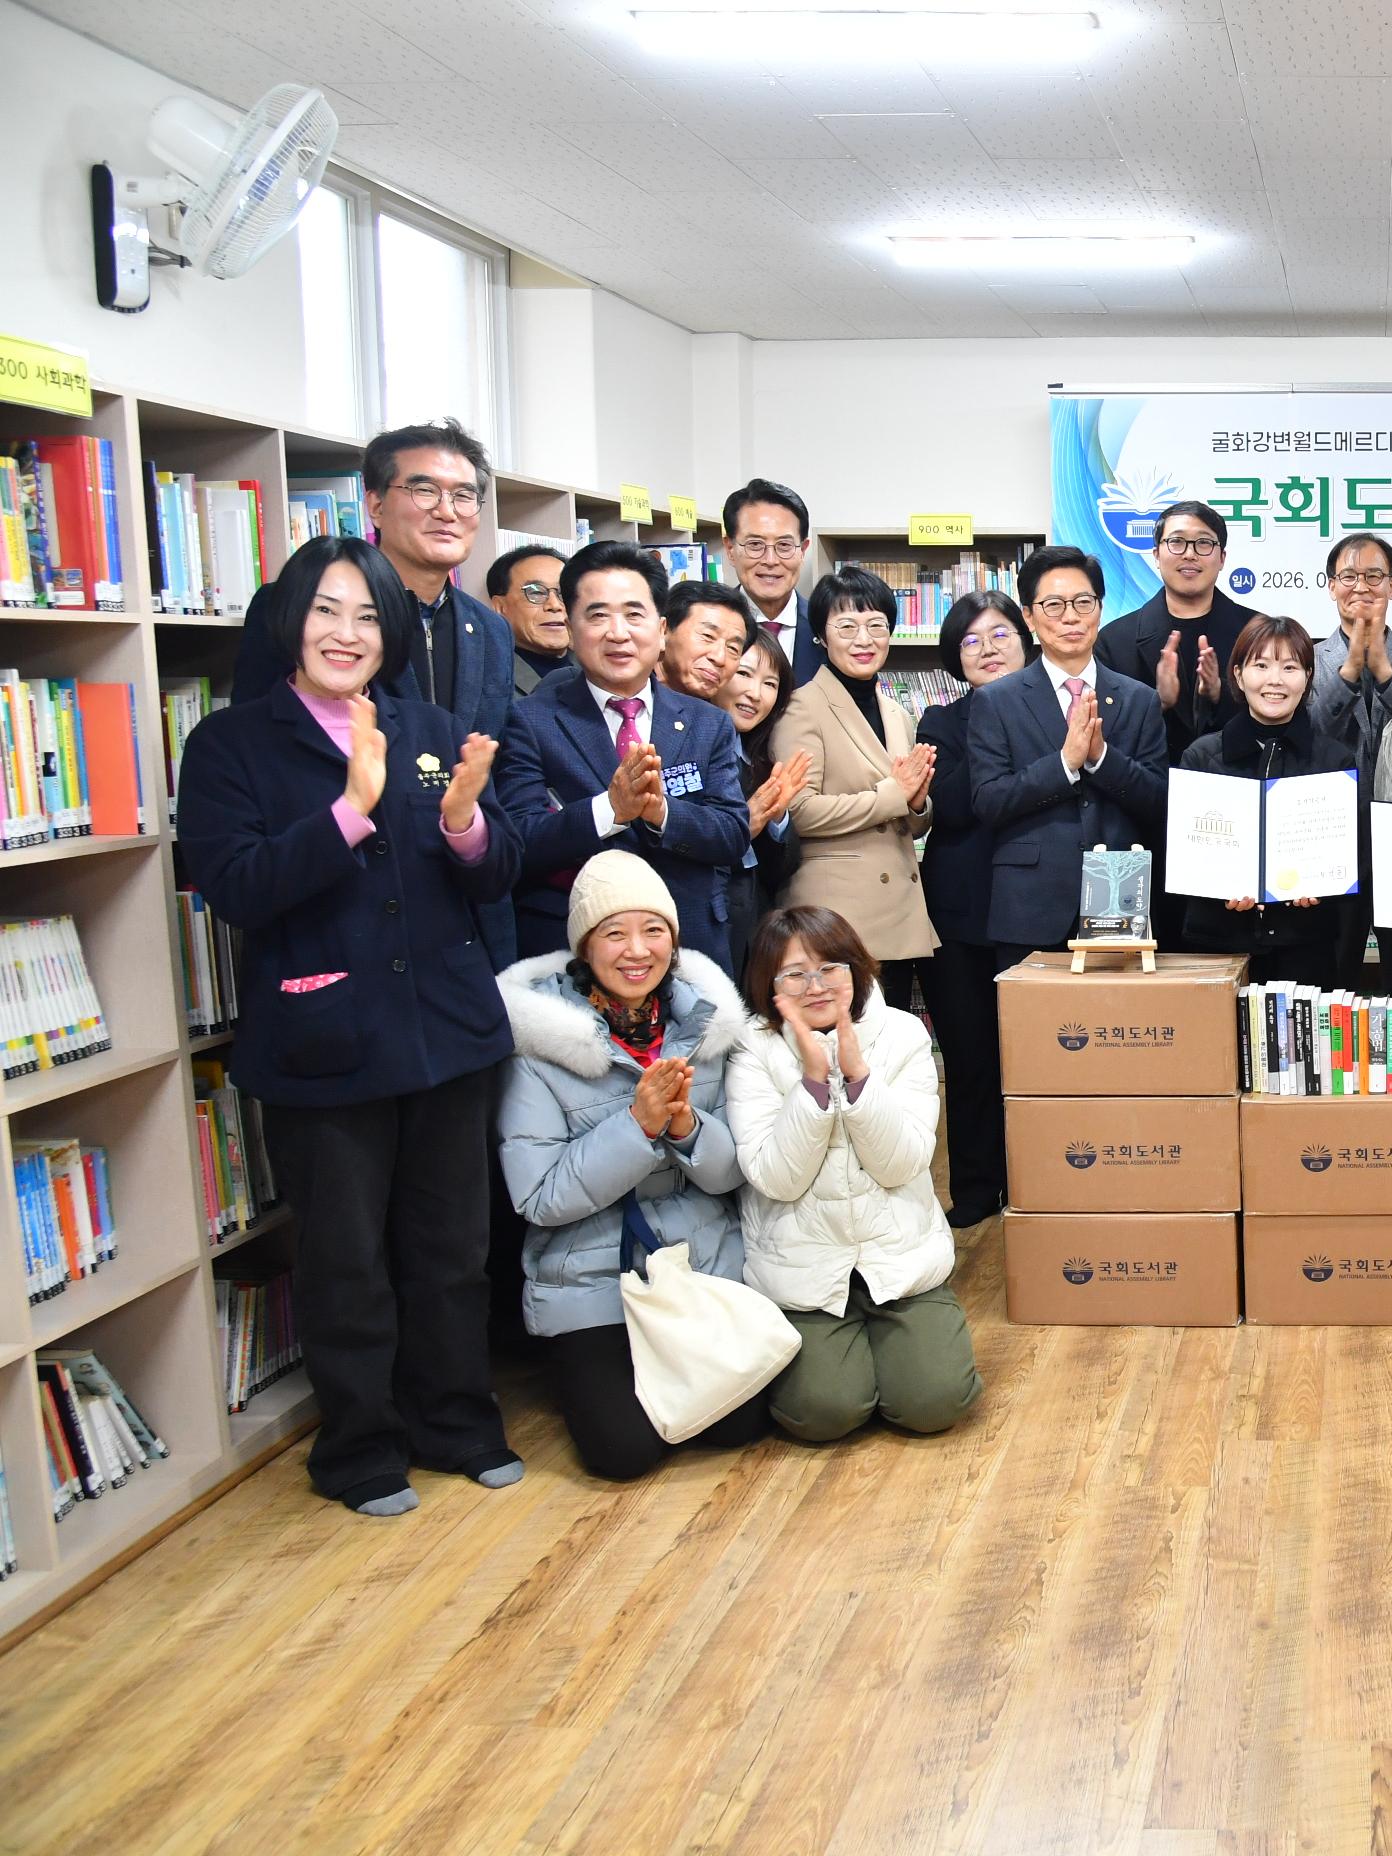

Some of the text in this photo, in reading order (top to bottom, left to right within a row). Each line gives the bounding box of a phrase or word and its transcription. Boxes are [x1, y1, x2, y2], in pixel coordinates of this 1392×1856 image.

[36, 365, 87, 395] 사회과학
[918, 525, 963, 534] 900 역사
[1232, 575, 1253, 588] 일시
[1262, 572, 1309, 590] 2026.
[1094, 1027, 1175, 1040] 국회도서관
[1102, 1145, 1182, 1158] 국회도서관
[1098, 1262, 1178, 1275] 국회도서관
